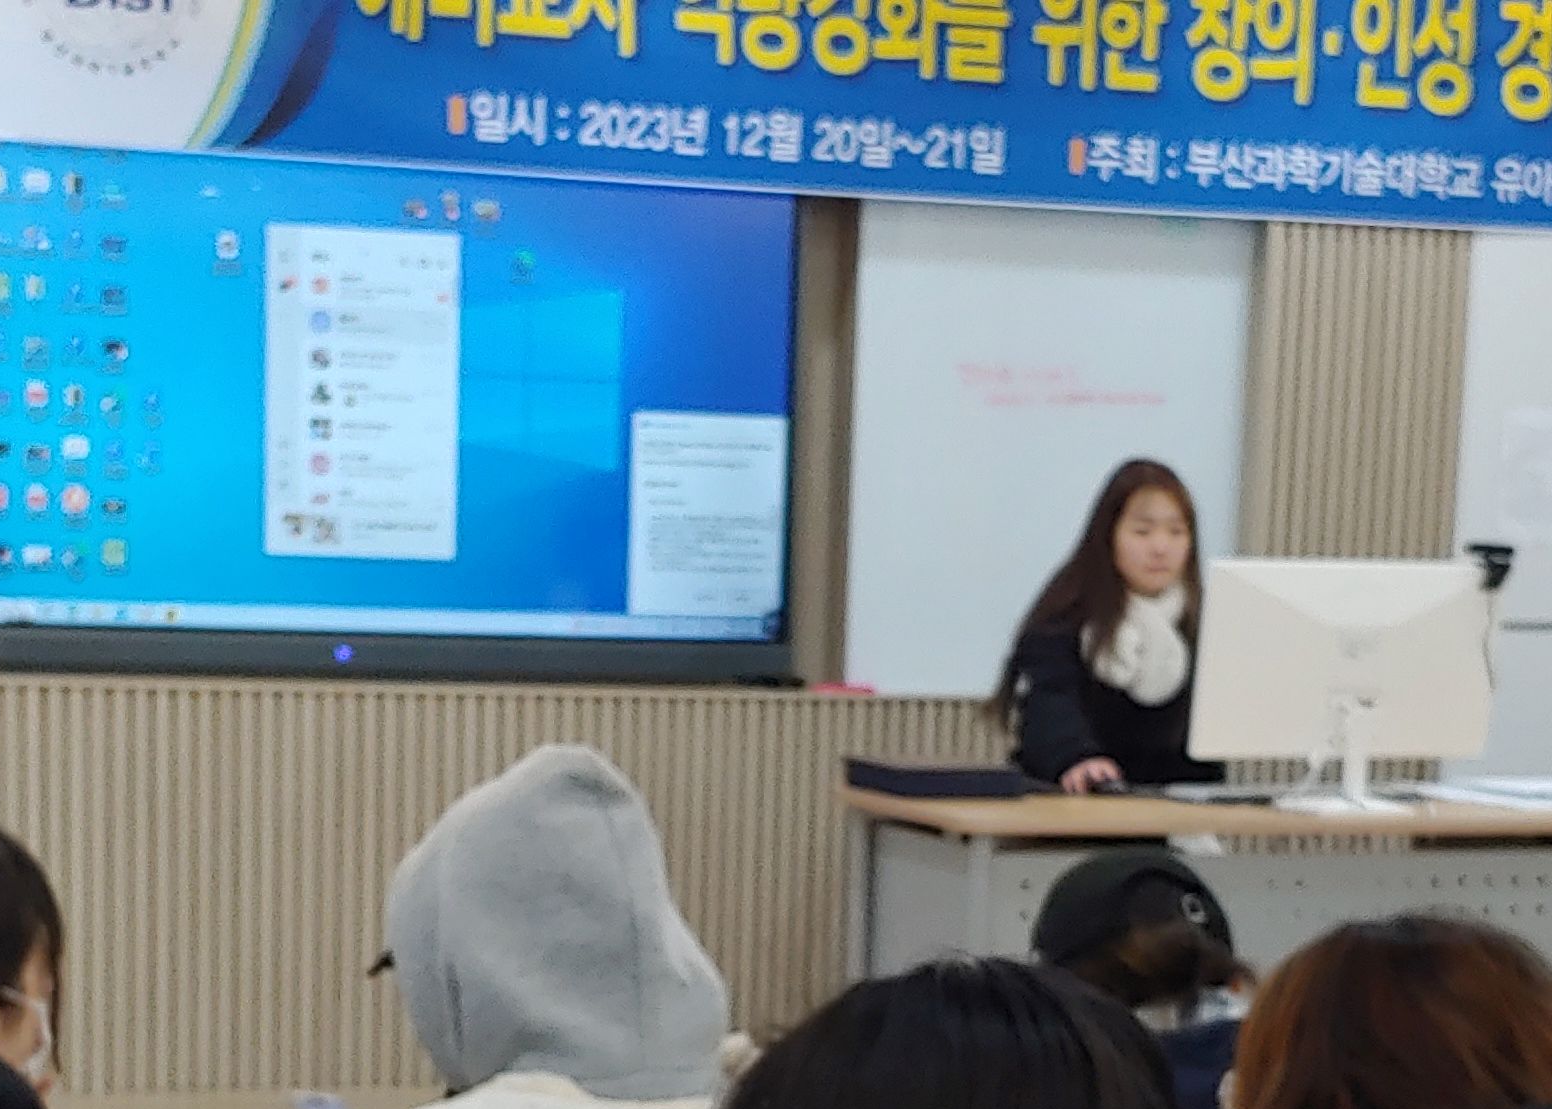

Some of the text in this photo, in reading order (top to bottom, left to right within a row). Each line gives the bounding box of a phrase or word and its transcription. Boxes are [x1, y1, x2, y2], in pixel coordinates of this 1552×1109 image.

[1032, 0, 1168, 93] 위한
[469, 90, 548, 146] 일시
[578, 100, 709, 158] 2023년
[723, 109, 803, 163] 12월
[1187, 140, 1484, 199] 부산과학기술대학교
